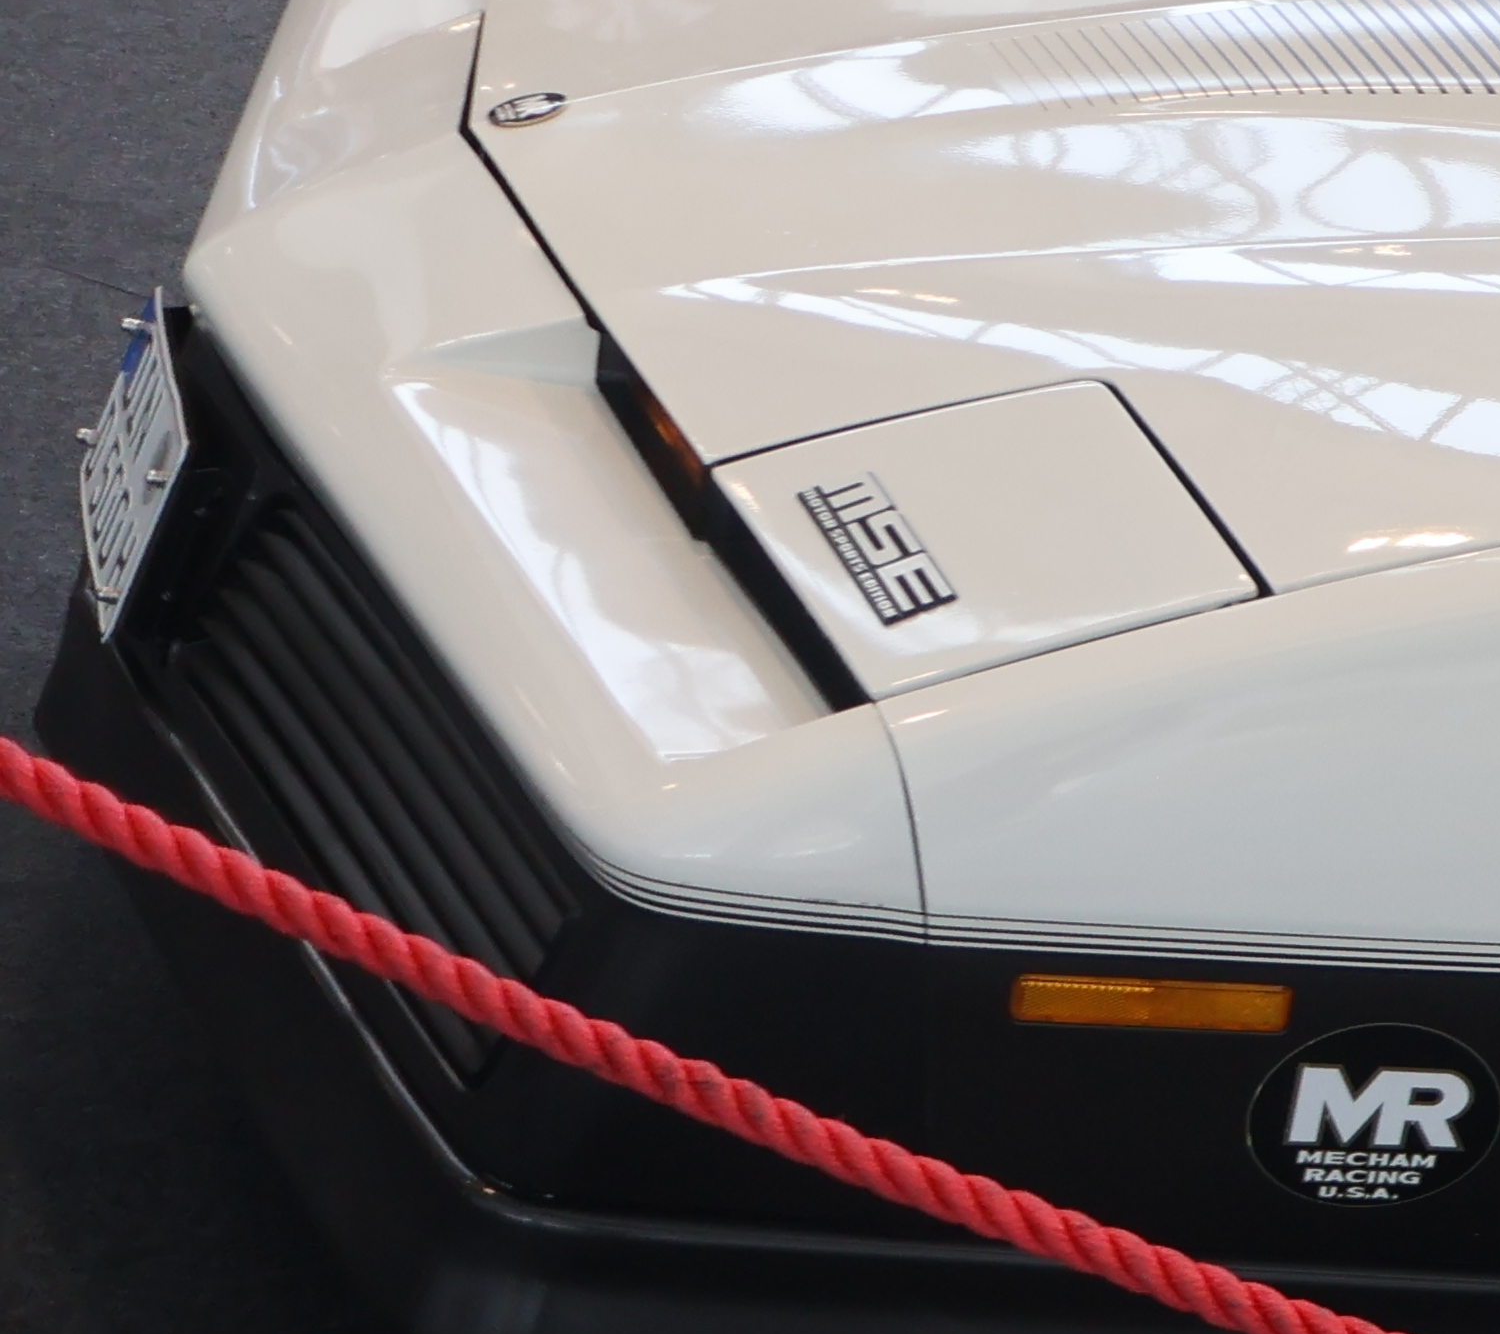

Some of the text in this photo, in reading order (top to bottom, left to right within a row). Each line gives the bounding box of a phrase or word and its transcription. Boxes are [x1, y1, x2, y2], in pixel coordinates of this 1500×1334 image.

[1283, 1062, 1475, 1151] MR
[1296, 1150, 1437, 1168] MECHAM
[1303, 1167, 1421, 1185] RACING
[1317, 1186, 1399, 1199] U.S.A.
